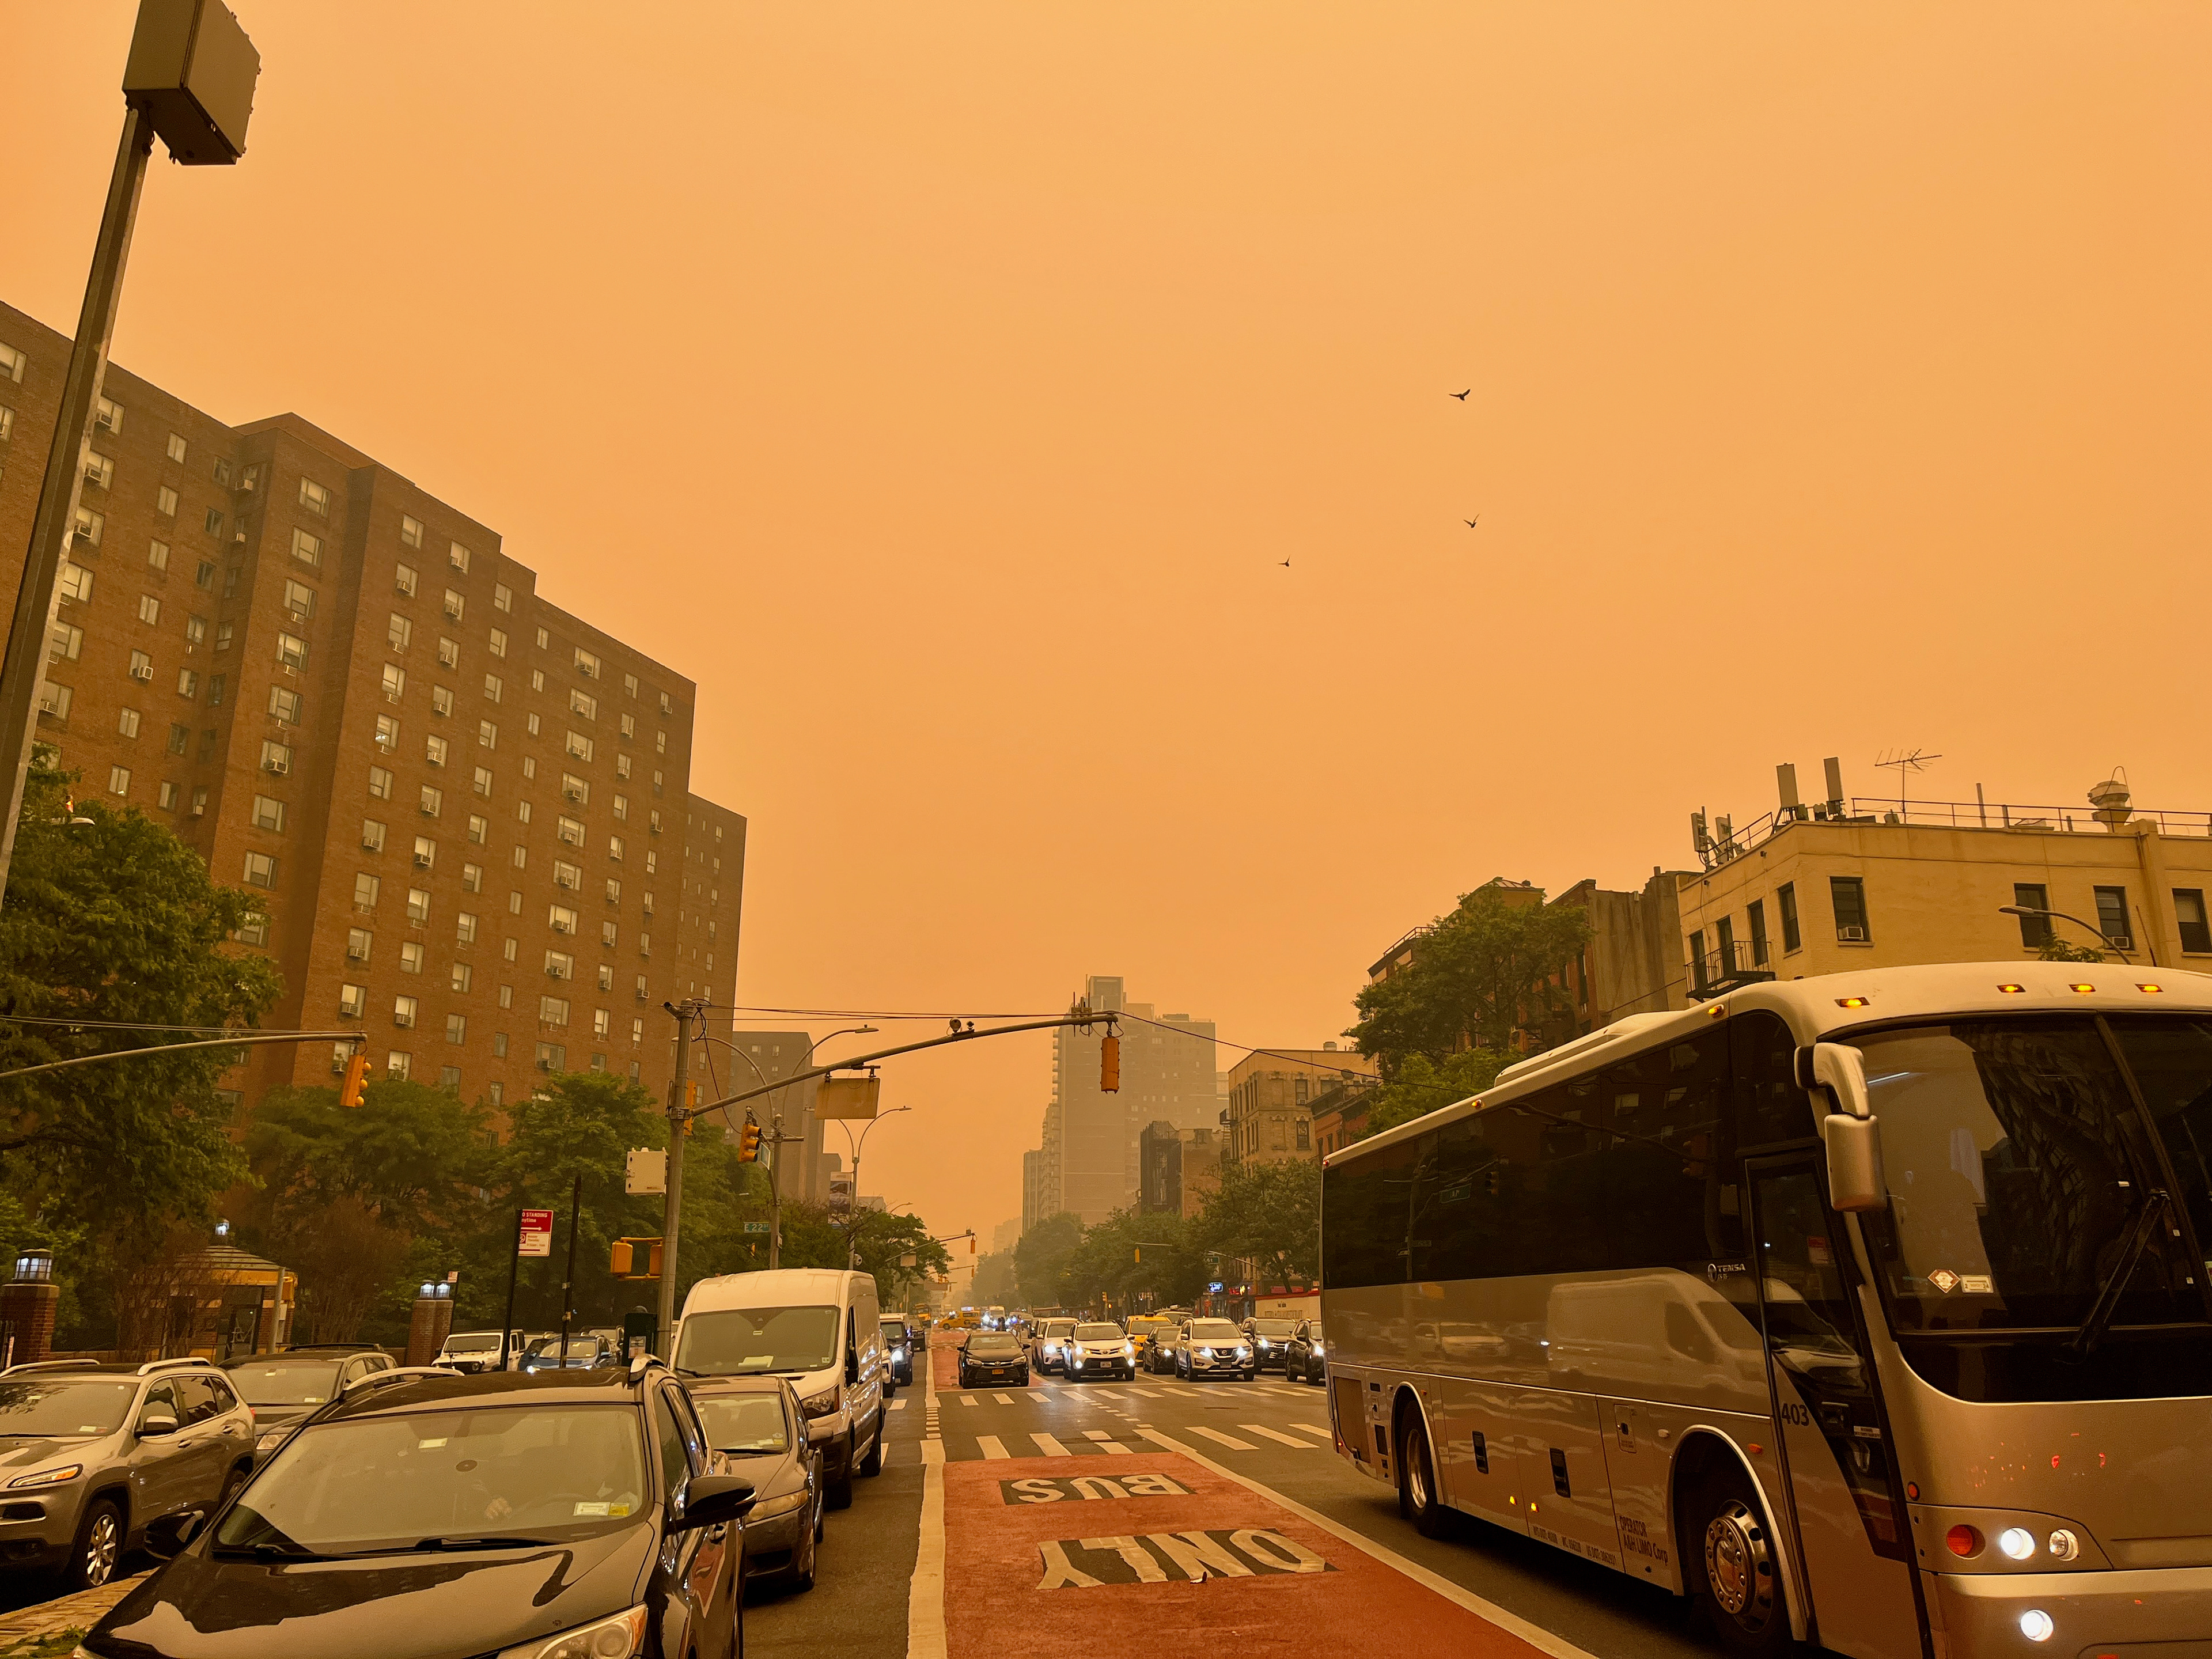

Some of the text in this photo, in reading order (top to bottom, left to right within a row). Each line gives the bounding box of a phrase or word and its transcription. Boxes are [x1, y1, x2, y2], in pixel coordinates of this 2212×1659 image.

[744, 1224, 749, 1232] E
[752, 1224, 763, 1232] 22
[1717, 1264, 1746, 1272] TEMSA
[1781, 1403, 1809, 1426] 403
[1011, 1474, 1190, 1503] BUS
[1619, 1515, 1648, 1539] OPERATOR
[1036, 1529, 1325, 1589] ONLY
[1636, 1537, 1653, 1558] LIMO
[1653, 1542, 1668, 1566] Corp
